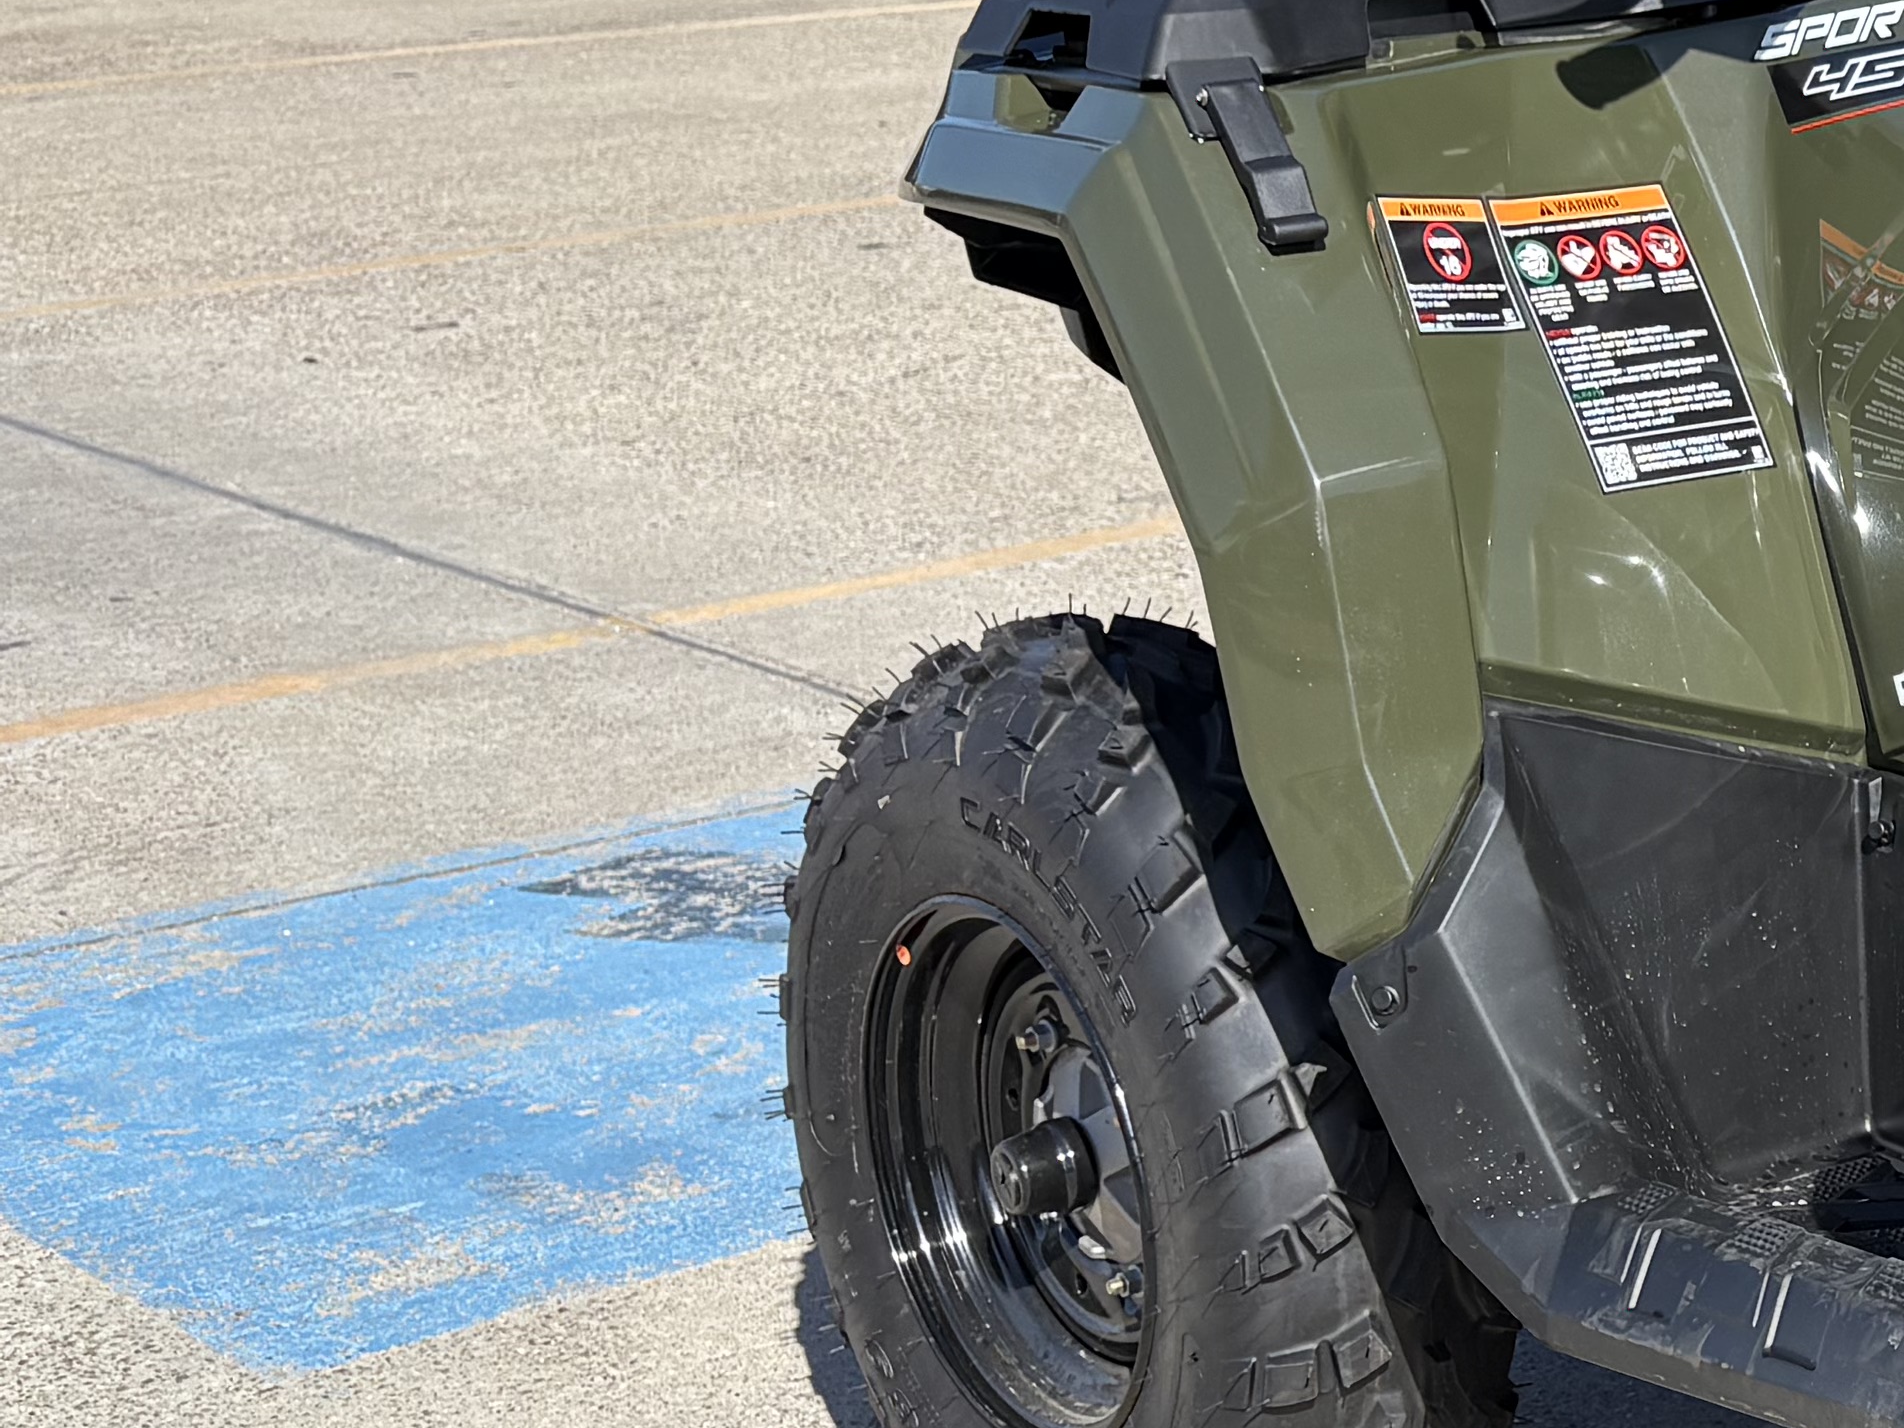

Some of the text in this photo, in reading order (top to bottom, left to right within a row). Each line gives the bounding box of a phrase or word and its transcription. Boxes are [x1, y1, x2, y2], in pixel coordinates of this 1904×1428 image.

[1410, 203, 1465, 218] WARNING
[1553, 195, 1620, 216] WARNING
[960, 796, 1138, 1028] CARLSTAR
